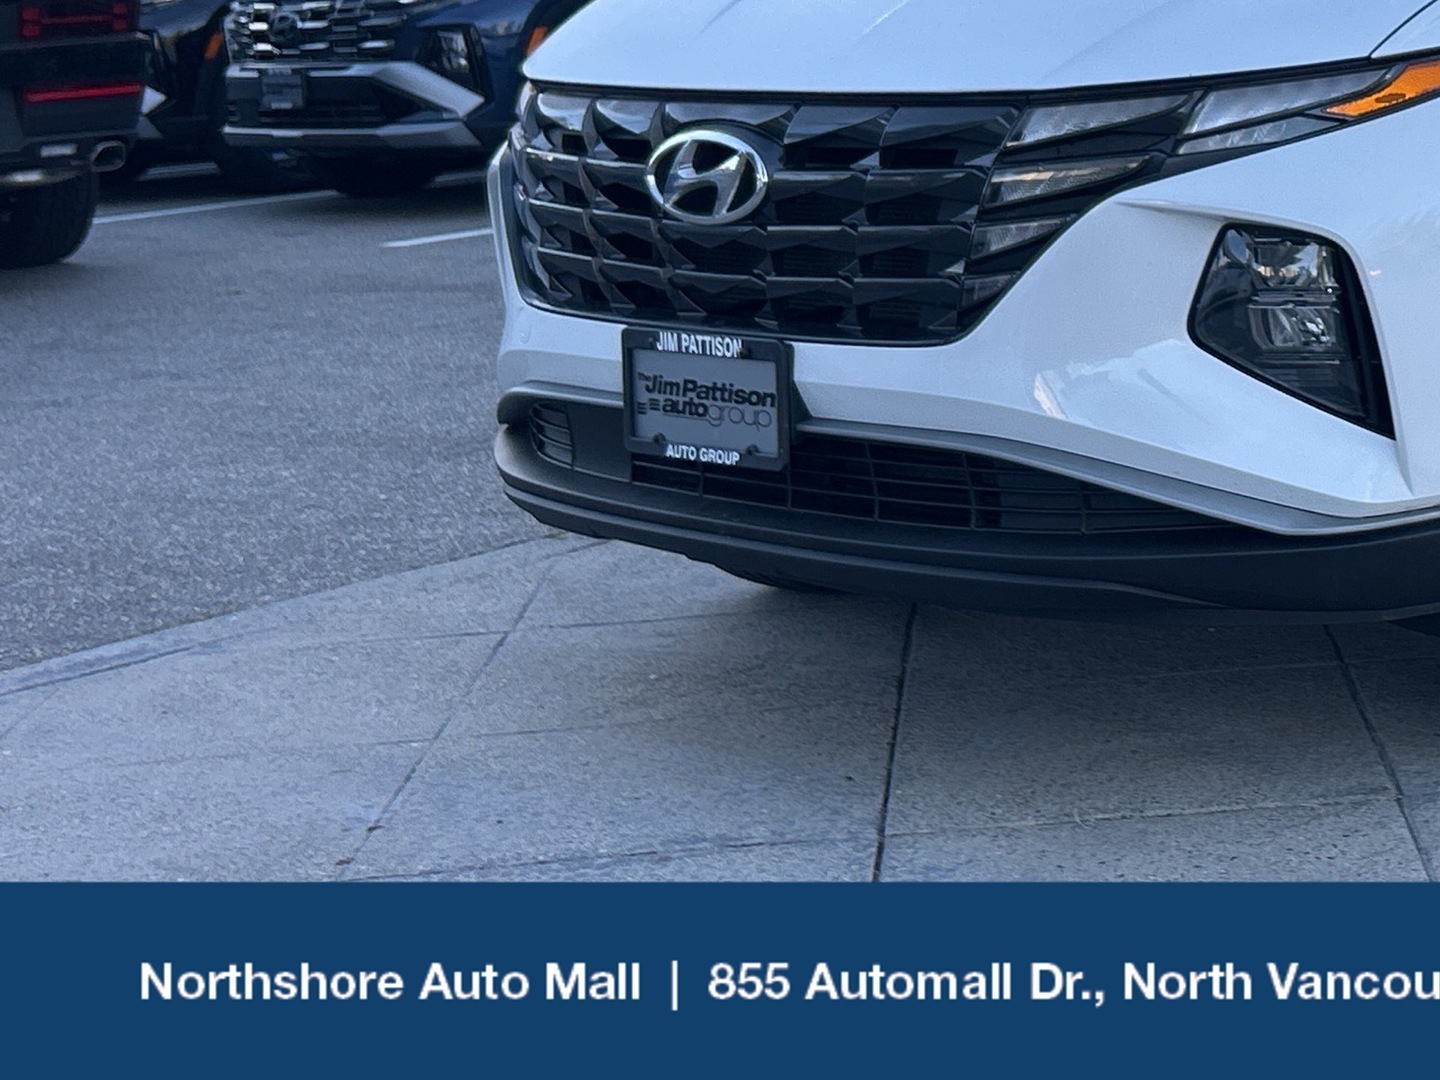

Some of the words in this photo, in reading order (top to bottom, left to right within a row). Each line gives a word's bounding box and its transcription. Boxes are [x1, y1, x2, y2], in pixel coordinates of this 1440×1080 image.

[656, 331, 680, 353] JIM
[681, 333, 743, 359] PATTISON
[666, 443, 697, 462] AUTO
[699, 446, 741, 466] GROUP
